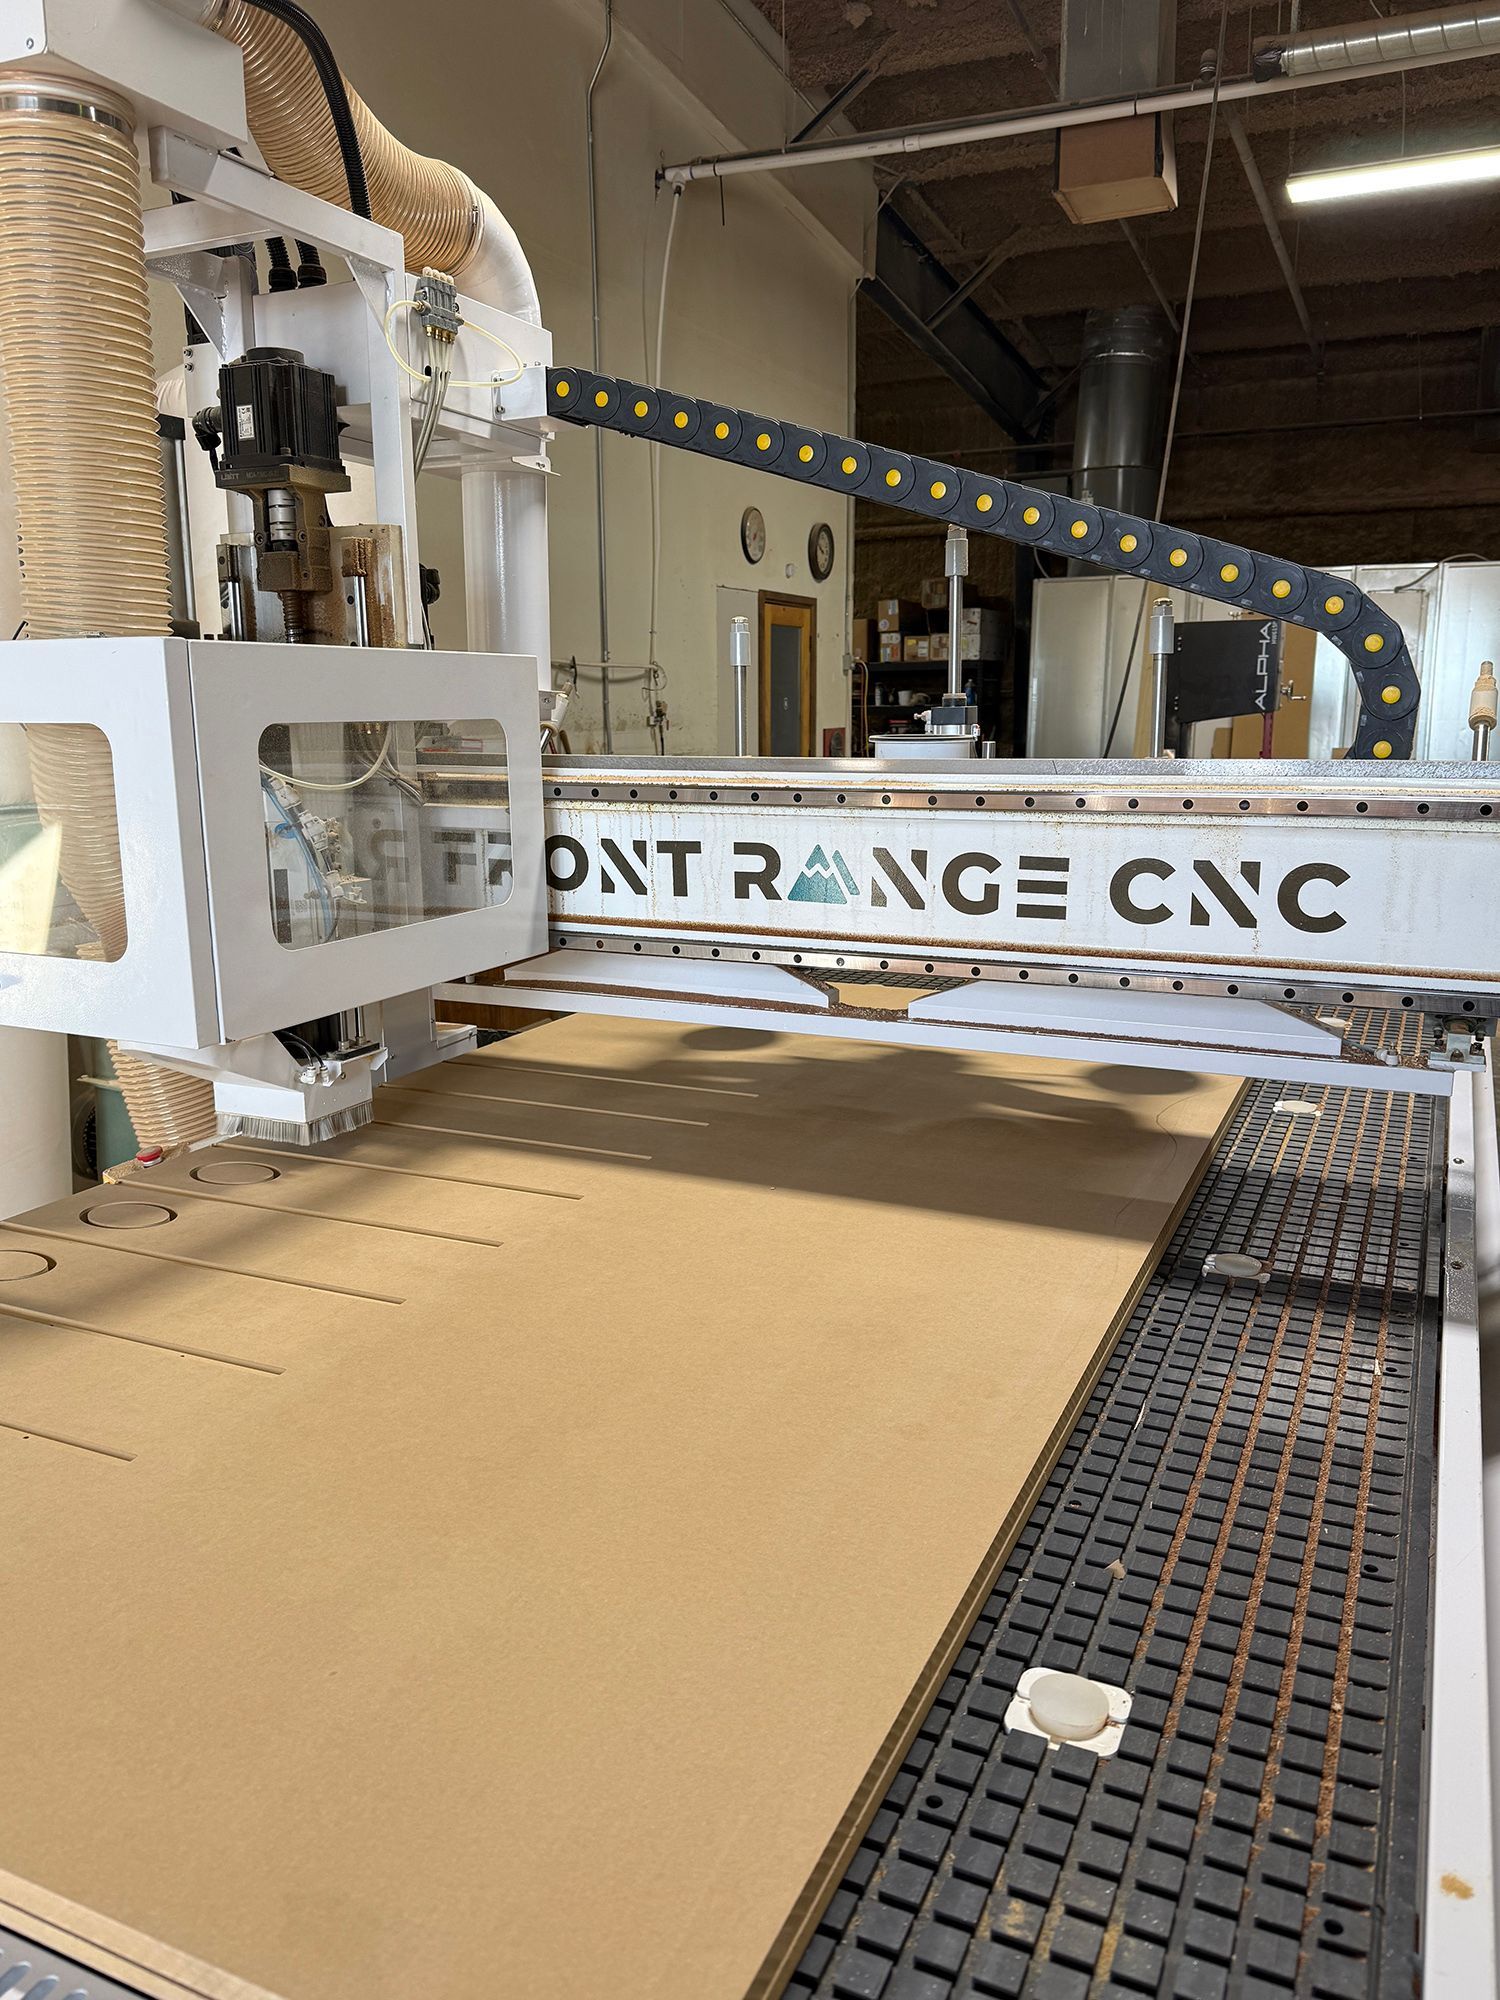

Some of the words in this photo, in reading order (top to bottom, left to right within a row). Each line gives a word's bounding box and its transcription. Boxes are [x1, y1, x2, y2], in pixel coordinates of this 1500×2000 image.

[1255, 621, 1272, 710] ALPHA
[733, 841, 1070, 921] RANGE
[1109, 857, 1351, 934] CNC
